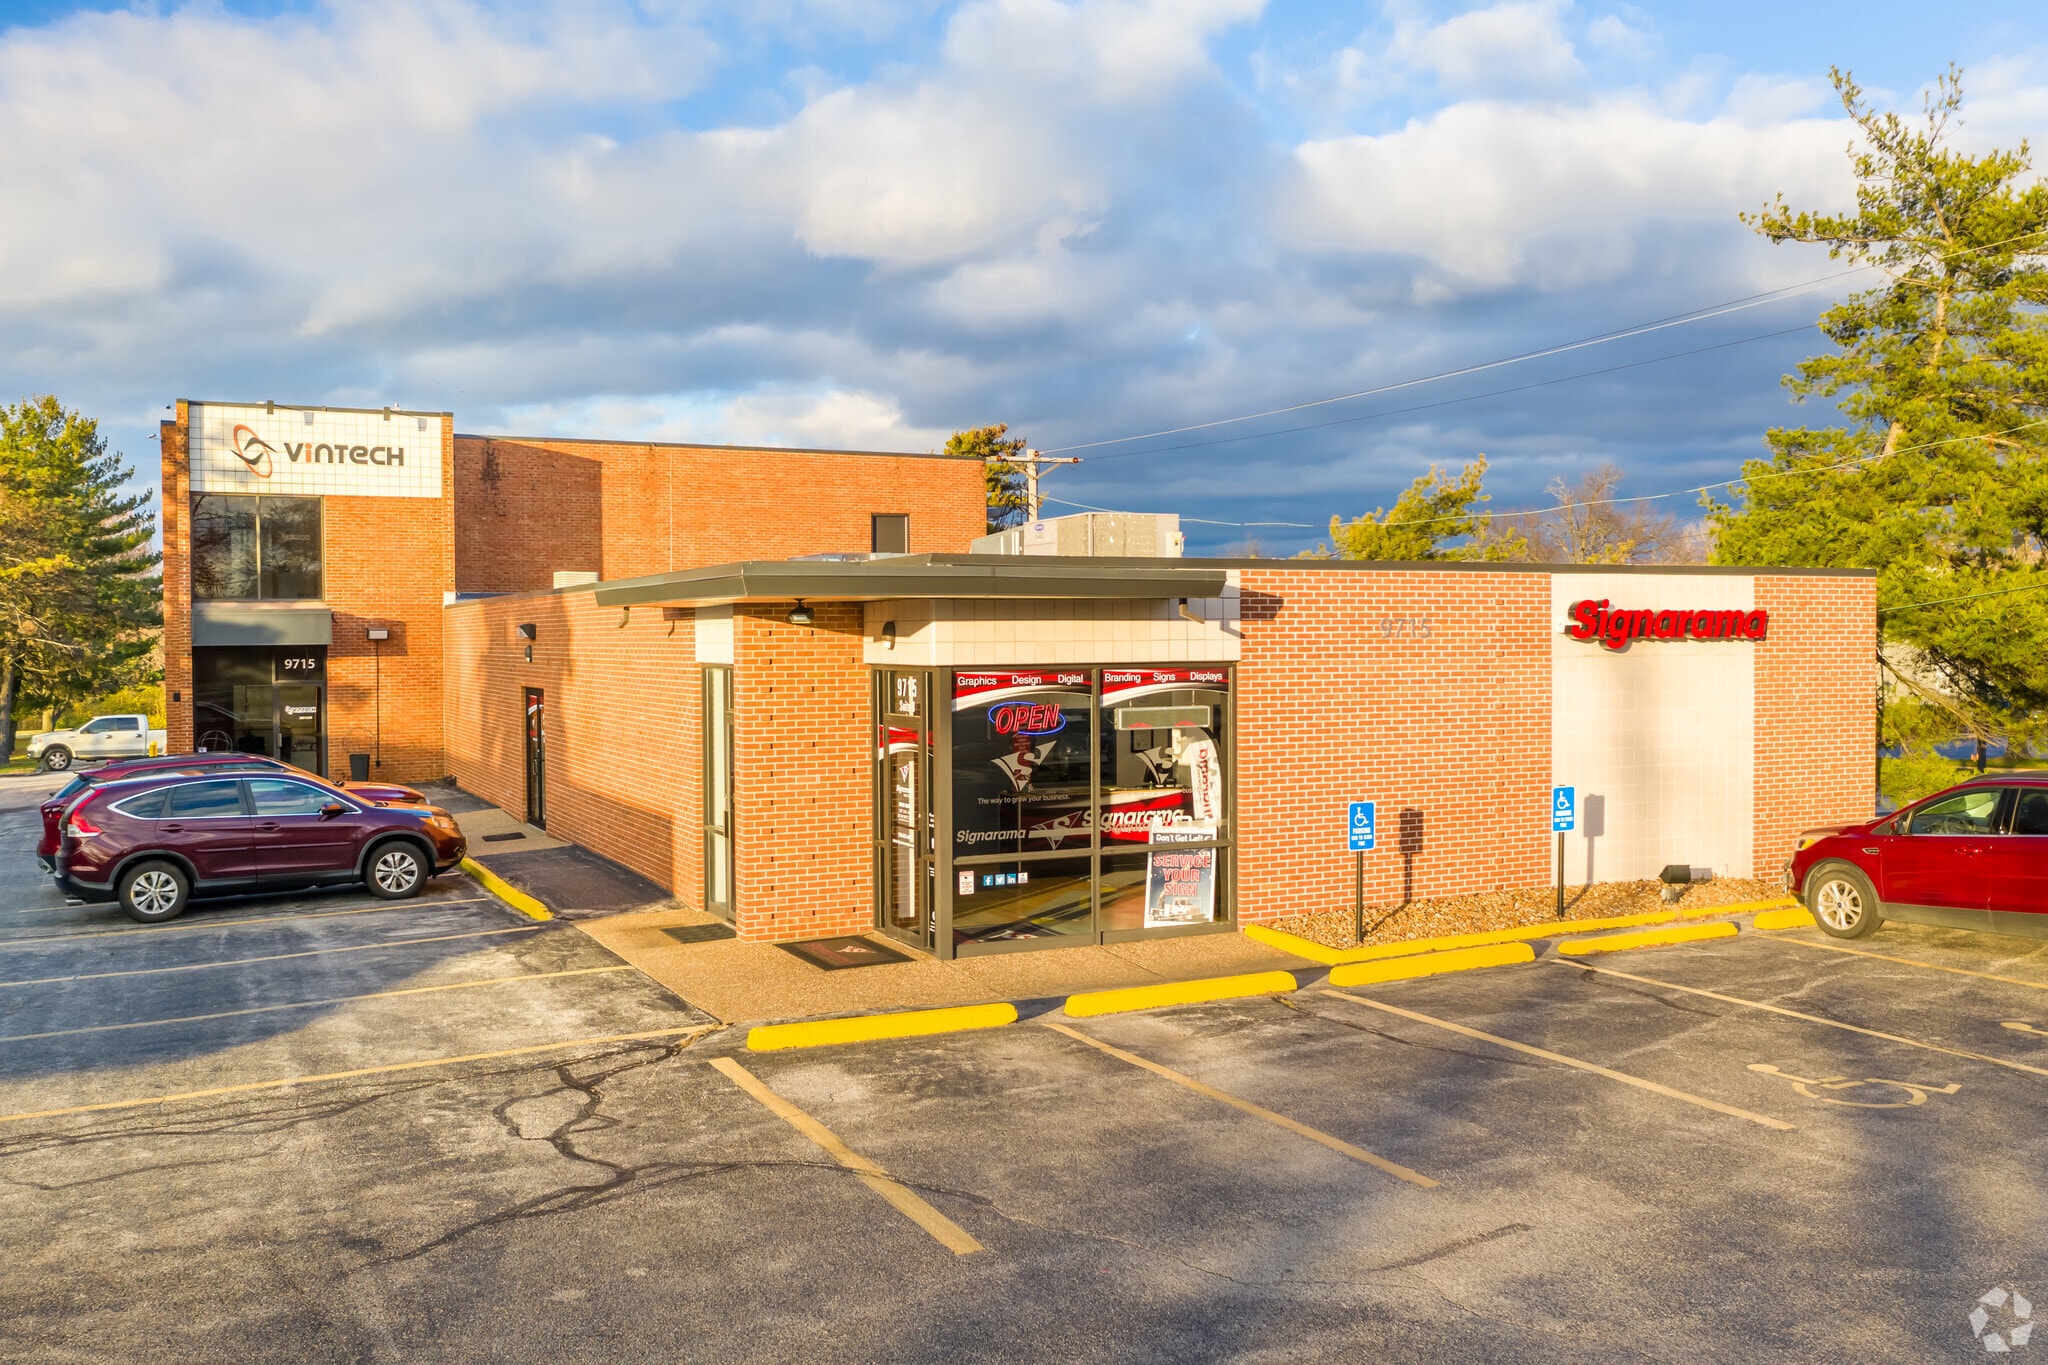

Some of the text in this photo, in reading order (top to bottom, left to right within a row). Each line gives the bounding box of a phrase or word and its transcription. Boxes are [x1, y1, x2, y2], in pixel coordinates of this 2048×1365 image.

[1380, 618, 1431, 638] 9715
[1570, 599, 1769, 650] Signarama
[284, 659, 315, 670] 9715
[958, 674, 1083, 686] Graphics Design Digital
[1104, 671, 1222, 683] Branding Signs Displays
[897, 678, 917, 697] 9715
[995, 704, 1061, 734] OPEN
[956, 829, 1026, 845] Signarama
[1153, 854, 1211, 867] SERVICE
[1163, 869, 1200, 882] YOUR
[1164, 883, 1197, 895] SIGN
